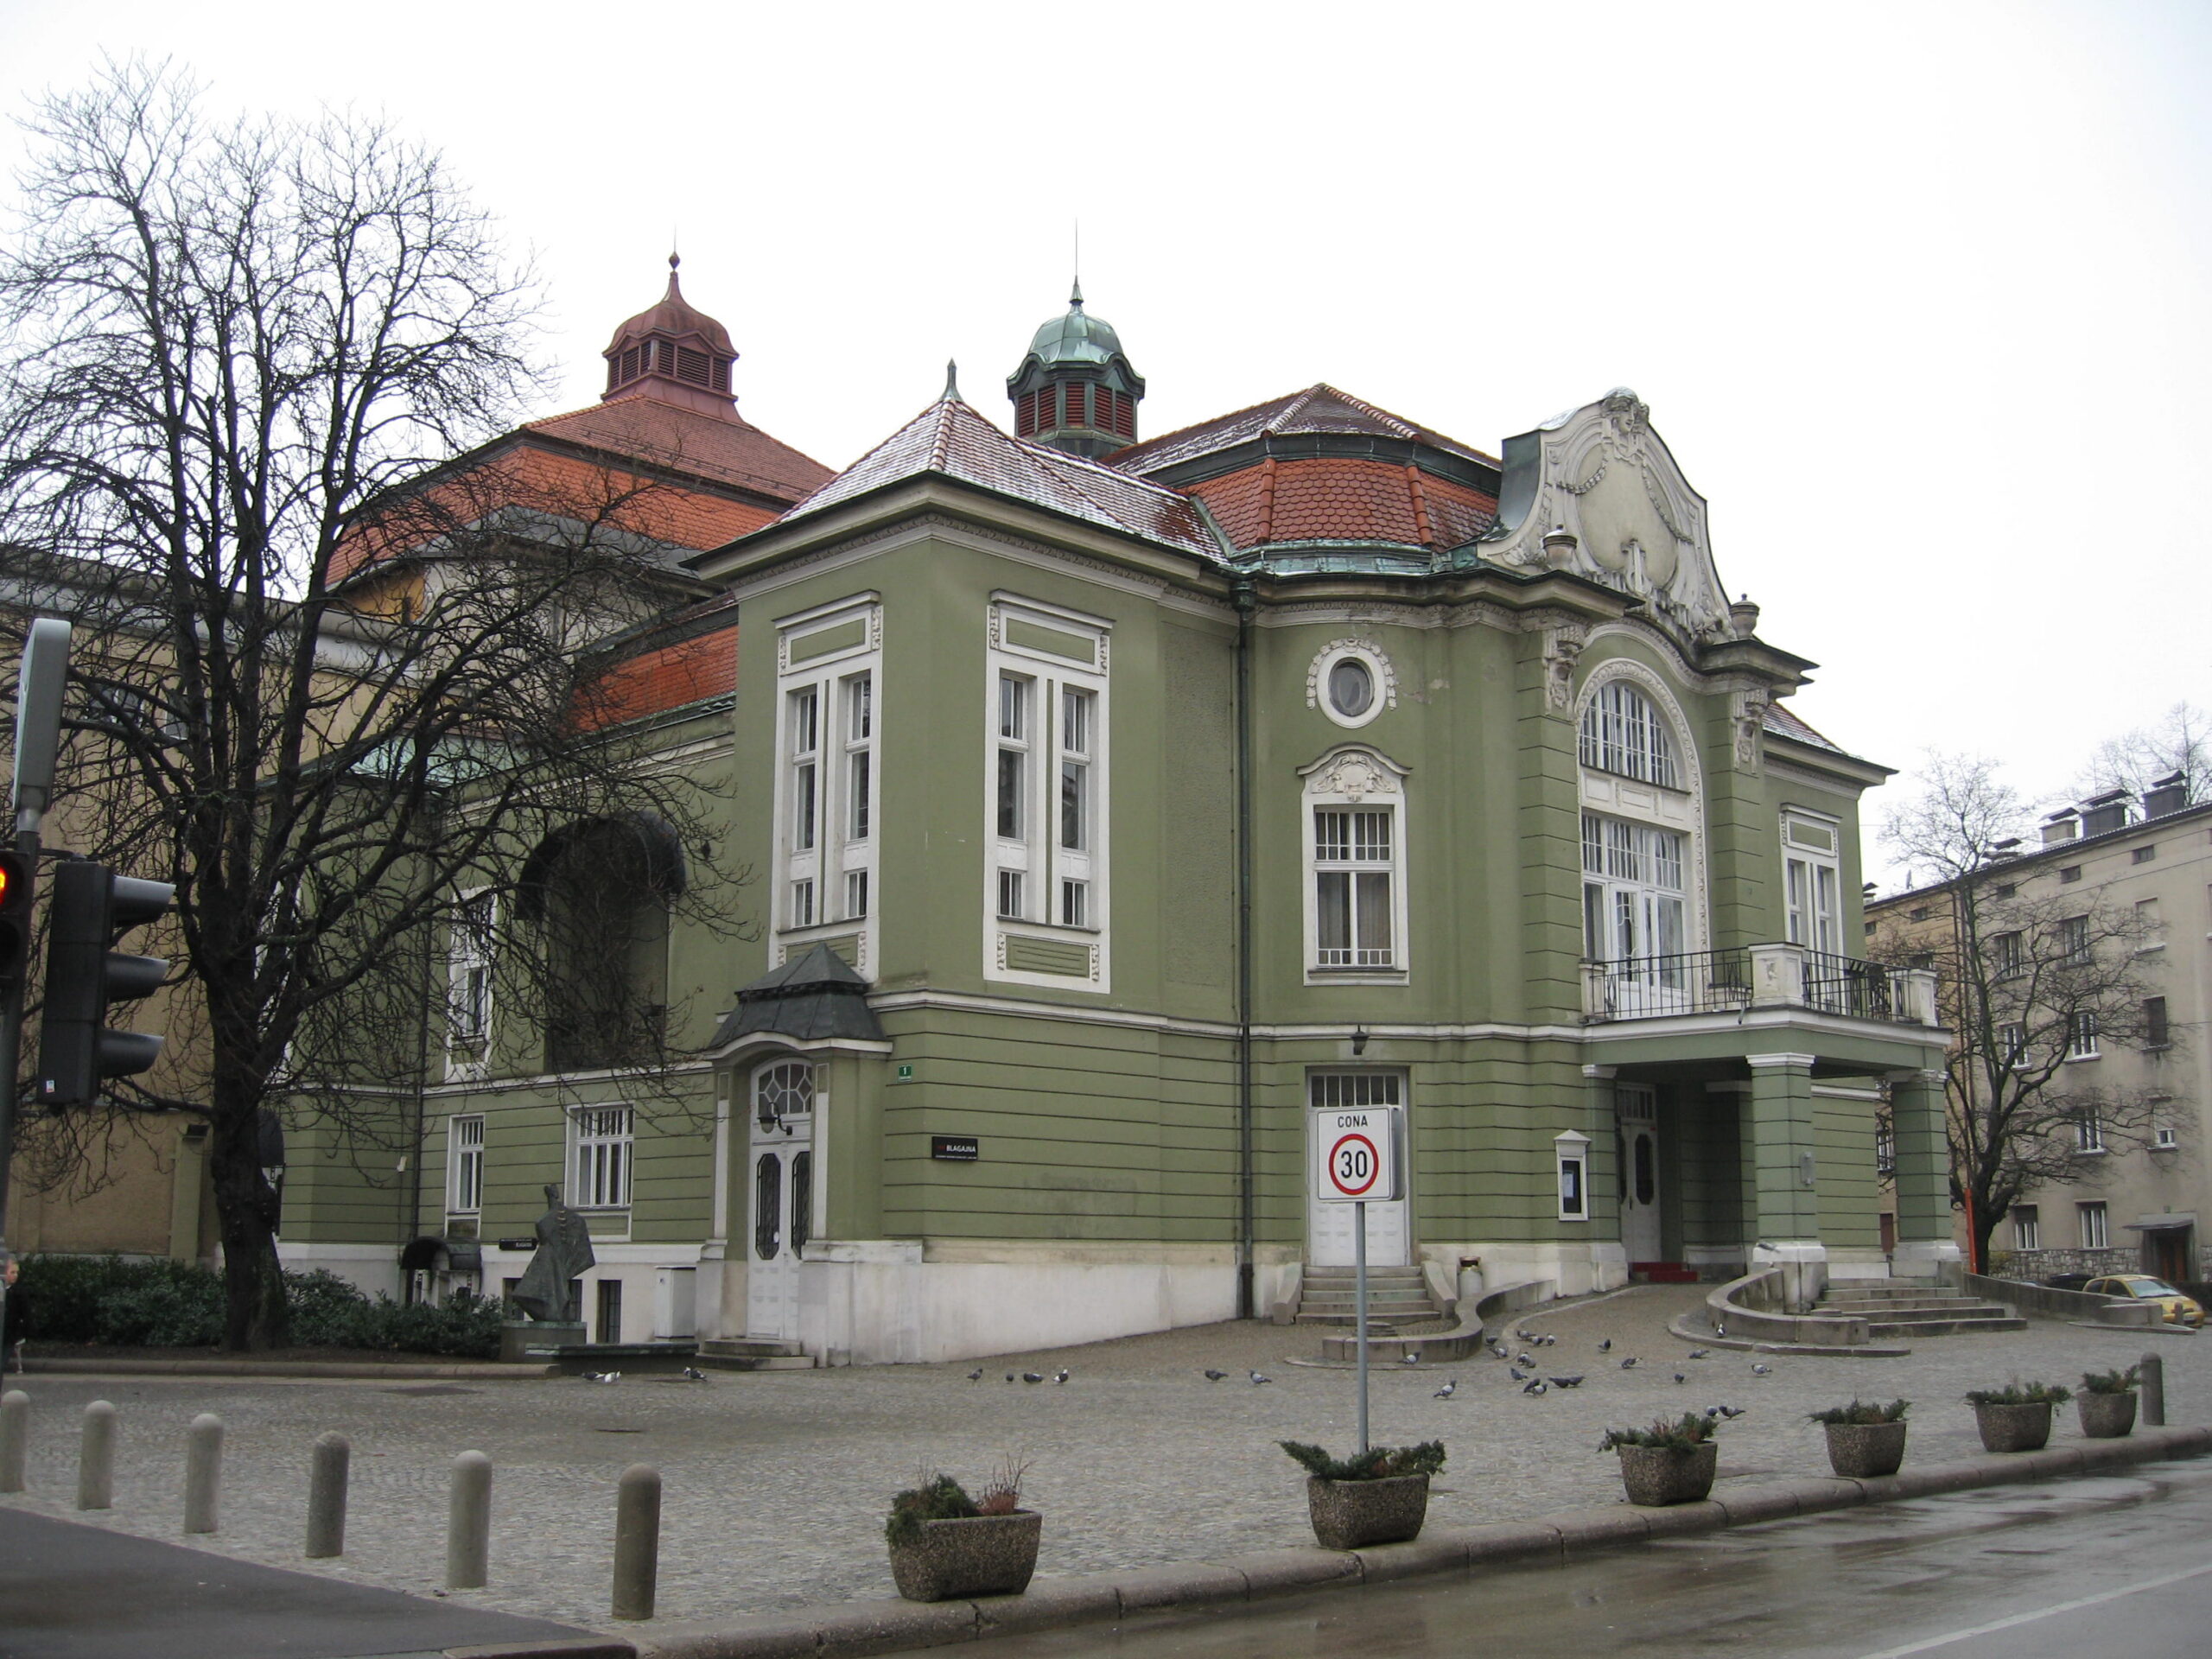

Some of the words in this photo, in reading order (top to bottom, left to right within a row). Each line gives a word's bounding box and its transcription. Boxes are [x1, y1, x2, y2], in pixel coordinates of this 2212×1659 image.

[1337, 1115, 1369, 1128] CONA
[946, 1144, 976, 1153] BLAGAJNA
[1340, 1150, 1368, 1179] 30
